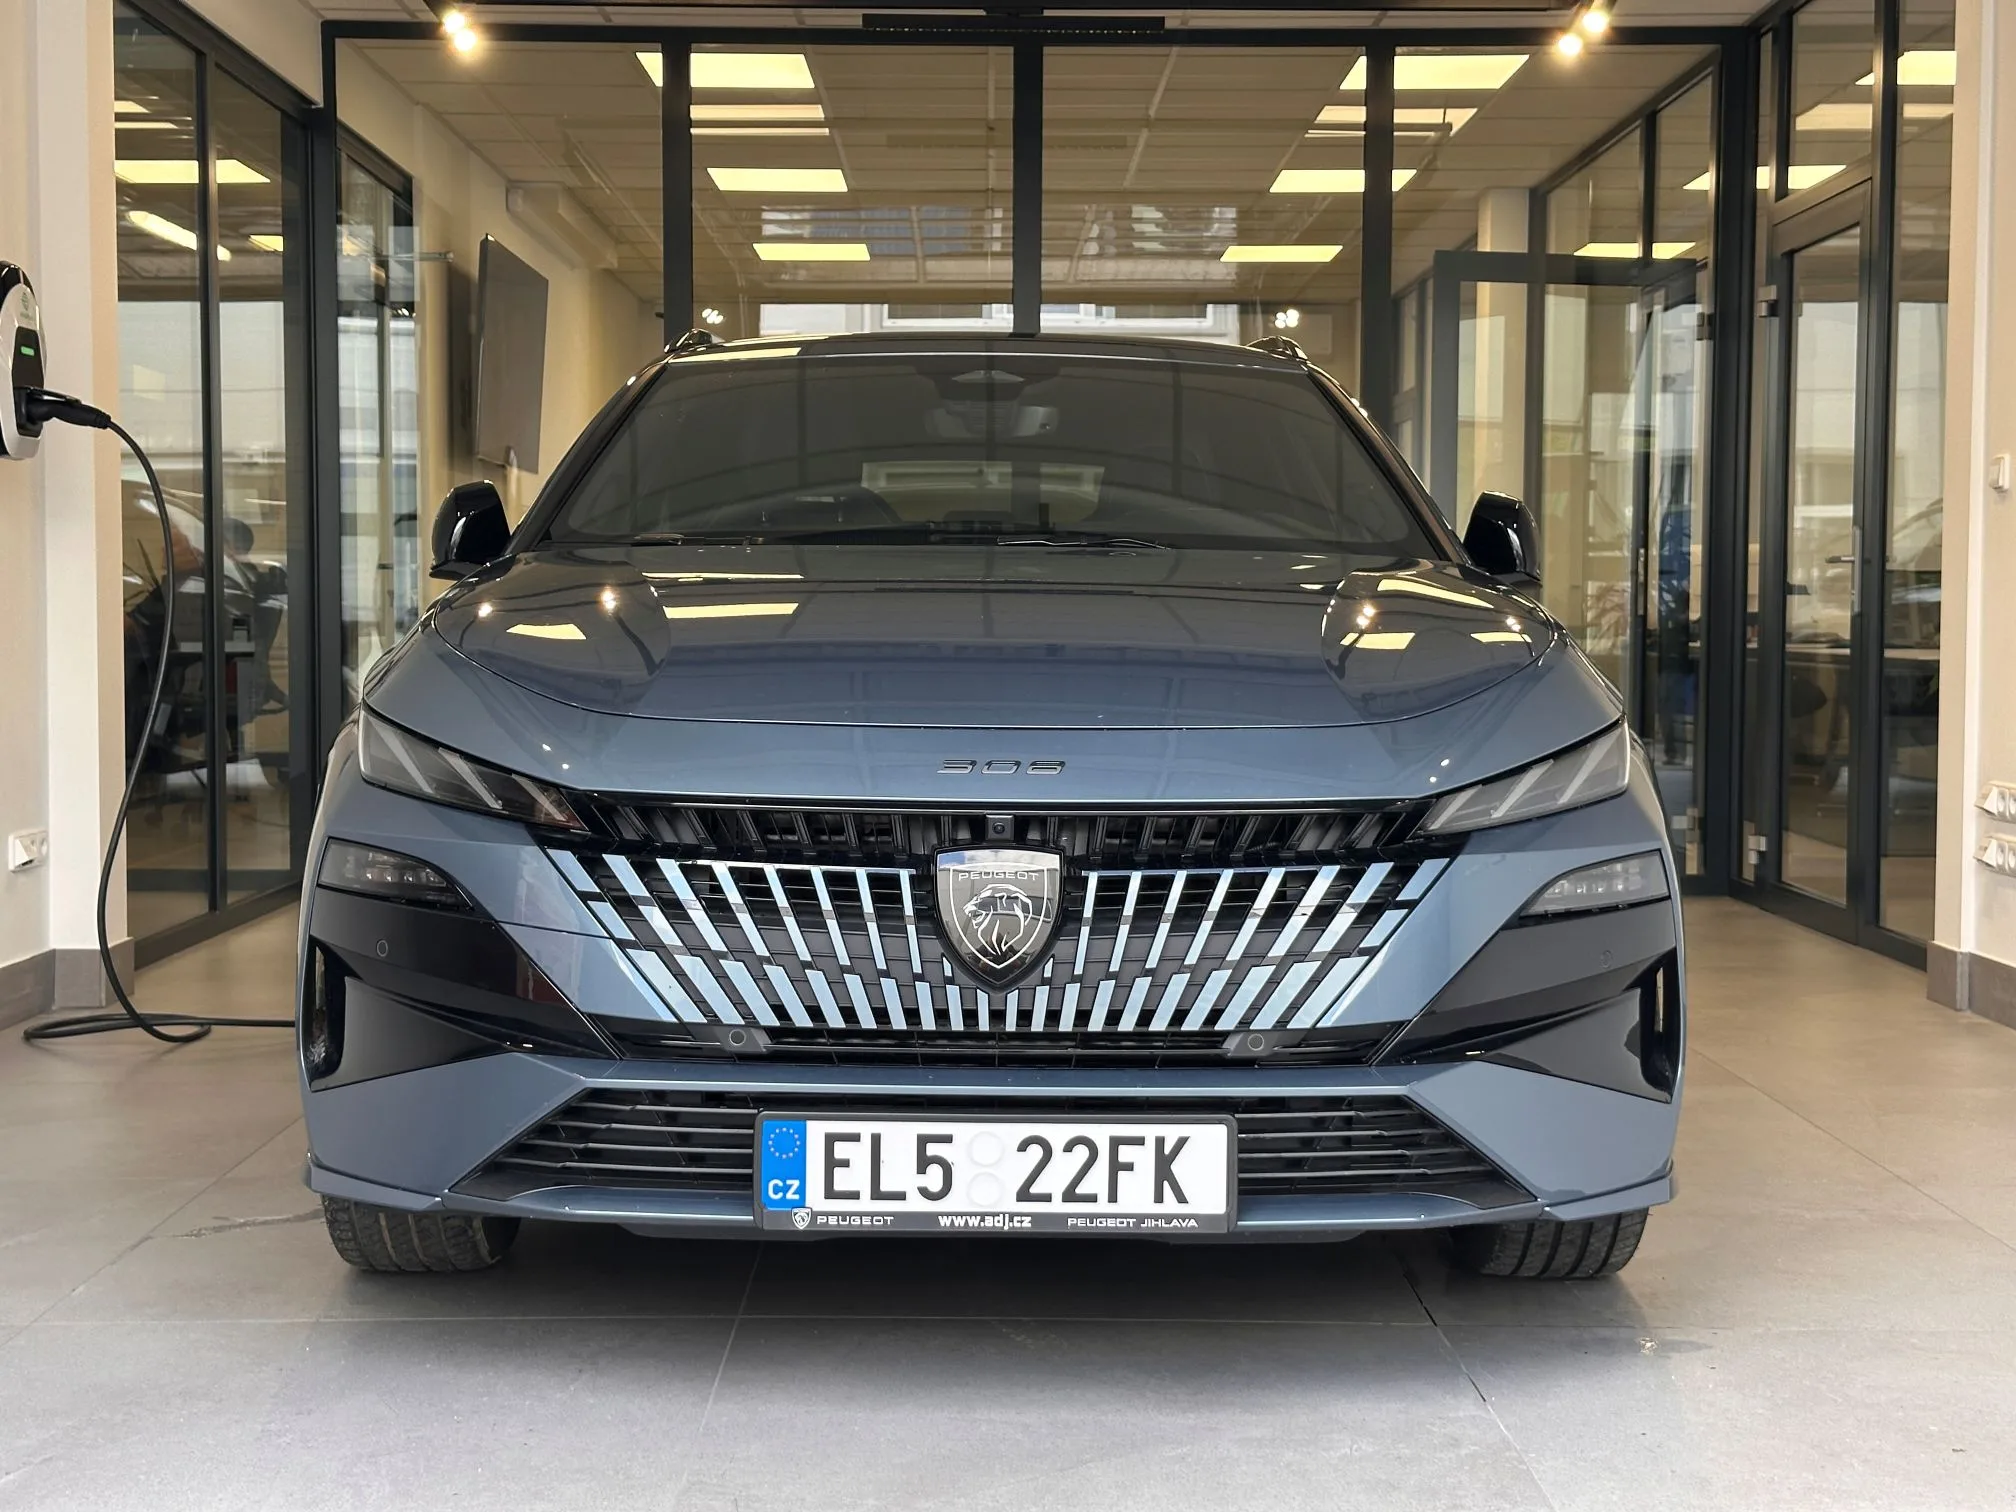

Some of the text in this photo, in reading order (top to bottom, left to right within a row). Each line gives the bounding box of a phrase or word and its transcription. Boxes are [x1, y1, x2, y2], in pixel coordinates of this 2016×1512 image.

[937, 759, 1066, 775] 308
[958, 870, 1039, 881] PEUGEOT
[824, 1132, 1191, 1204] EL5 22FK
[768, 1179, 800, 1200] CZ
[816, 1215, 894, 1225] PEUGEOT
[938, 1213, 1032, 1230] www.adj.cz
[1067, 1217, 1199, 1228] PEUGEOT JIHLAVA
